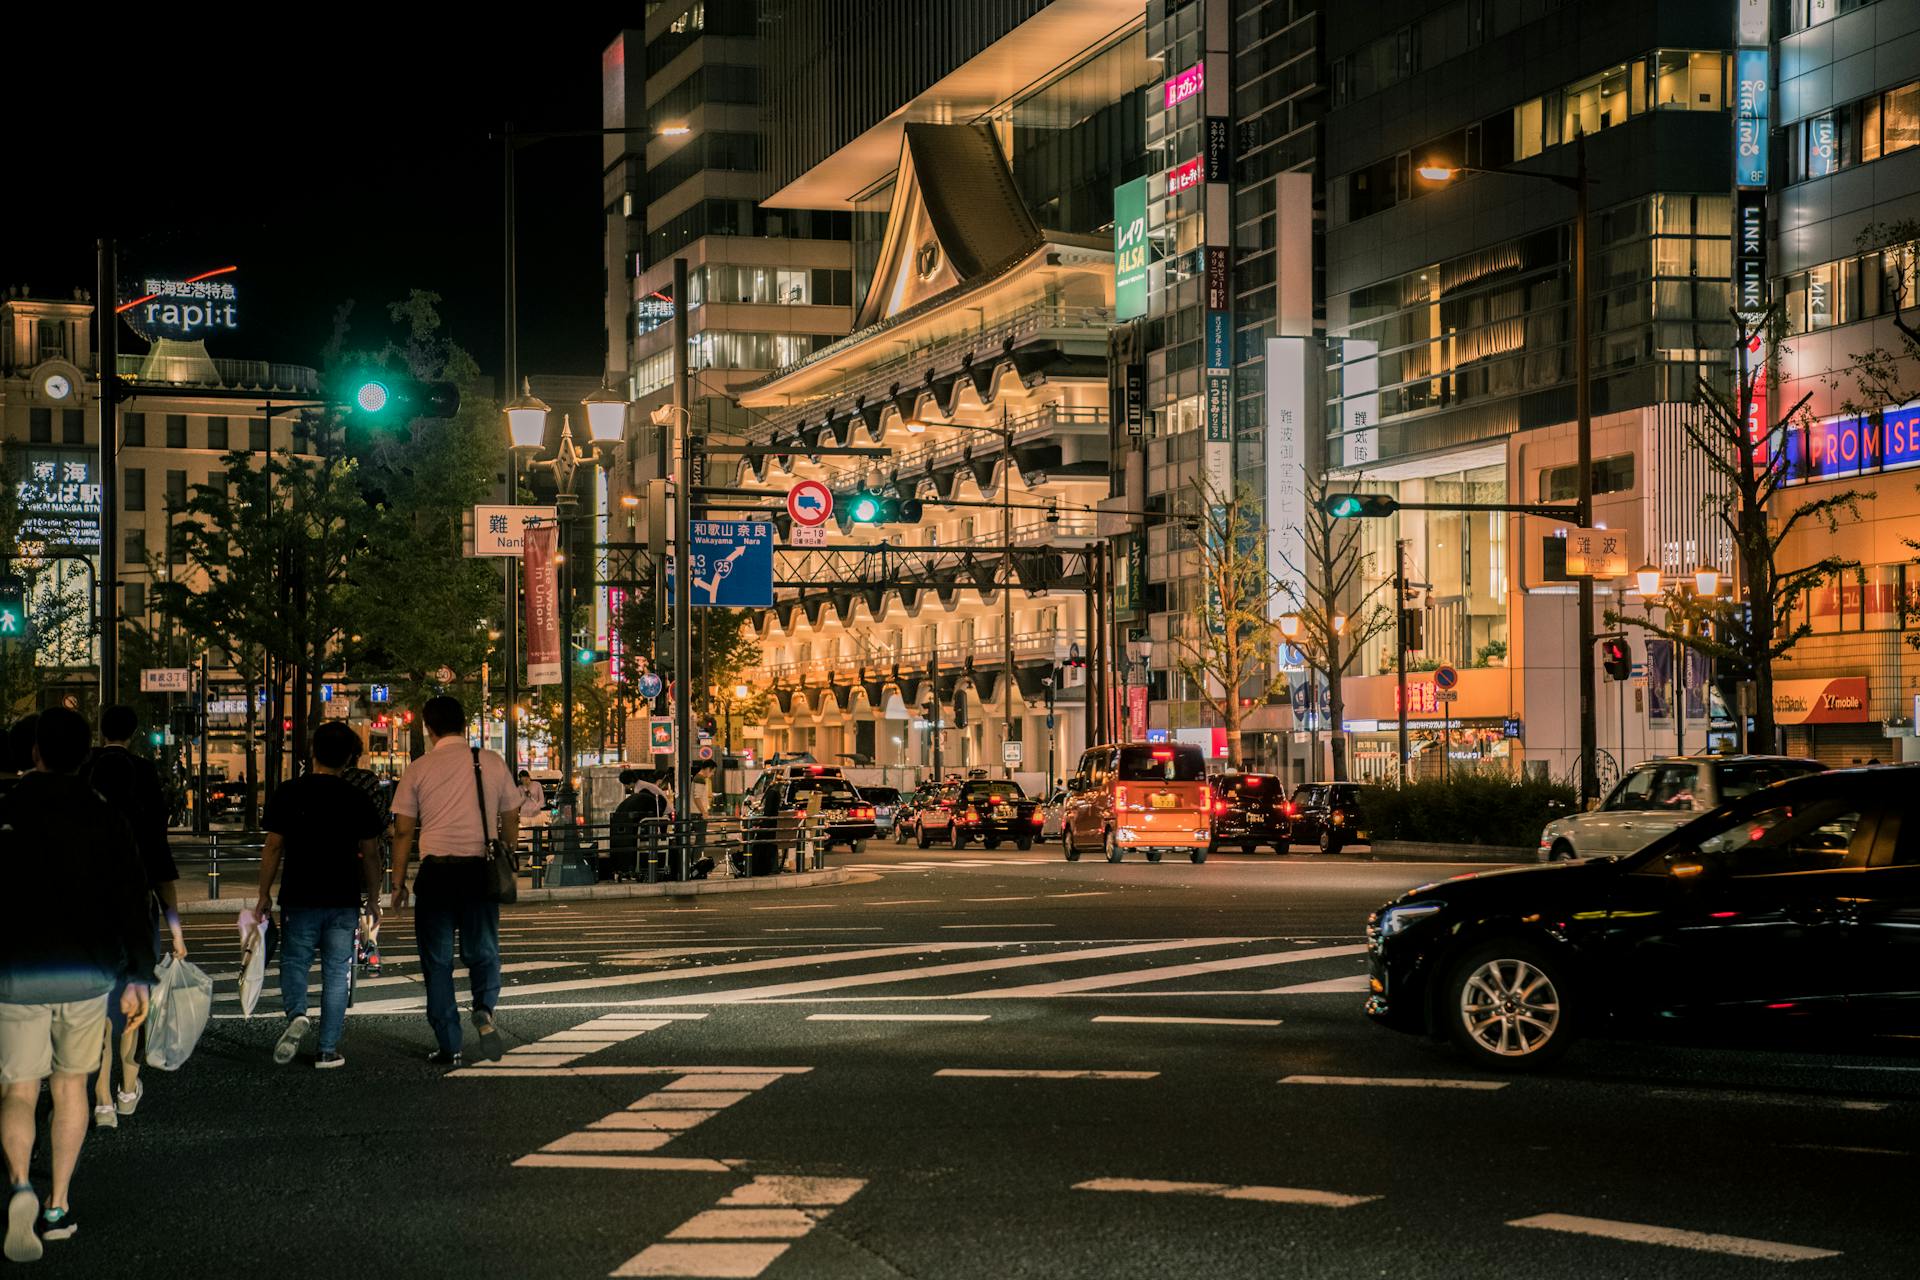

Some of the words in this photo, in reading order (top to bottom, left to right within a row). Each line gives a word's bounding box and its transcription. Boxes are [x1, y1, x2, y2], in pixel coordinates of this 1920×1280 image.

[1741, 81, 1752, 157] KIREIMO
[1751, 170, 1763, 182] 8F
[1117, 217, 1144, 250] レイク
[1745, 207, 1759, 254] LINK
[1117, 245, 1145, 275] ALSA
[145, 279, 236, 299] 南海空港特急
[1745, 262, 1759, 308] LINK
[1810, 417, 1920, 469] PROMISE
[694, 523, 733, 536] 和歌山
[737, 524, 767, 537] 奈良
[694, 537, 733, 545] Wakayama
[1577, 537, 1617, 554] 難波
[535, 567, 543, 580] in
[717, 562, 730, 572] 25
[535, 583, 543, 626] Union
[1822, 694, 1860, 709] Y!mobile
